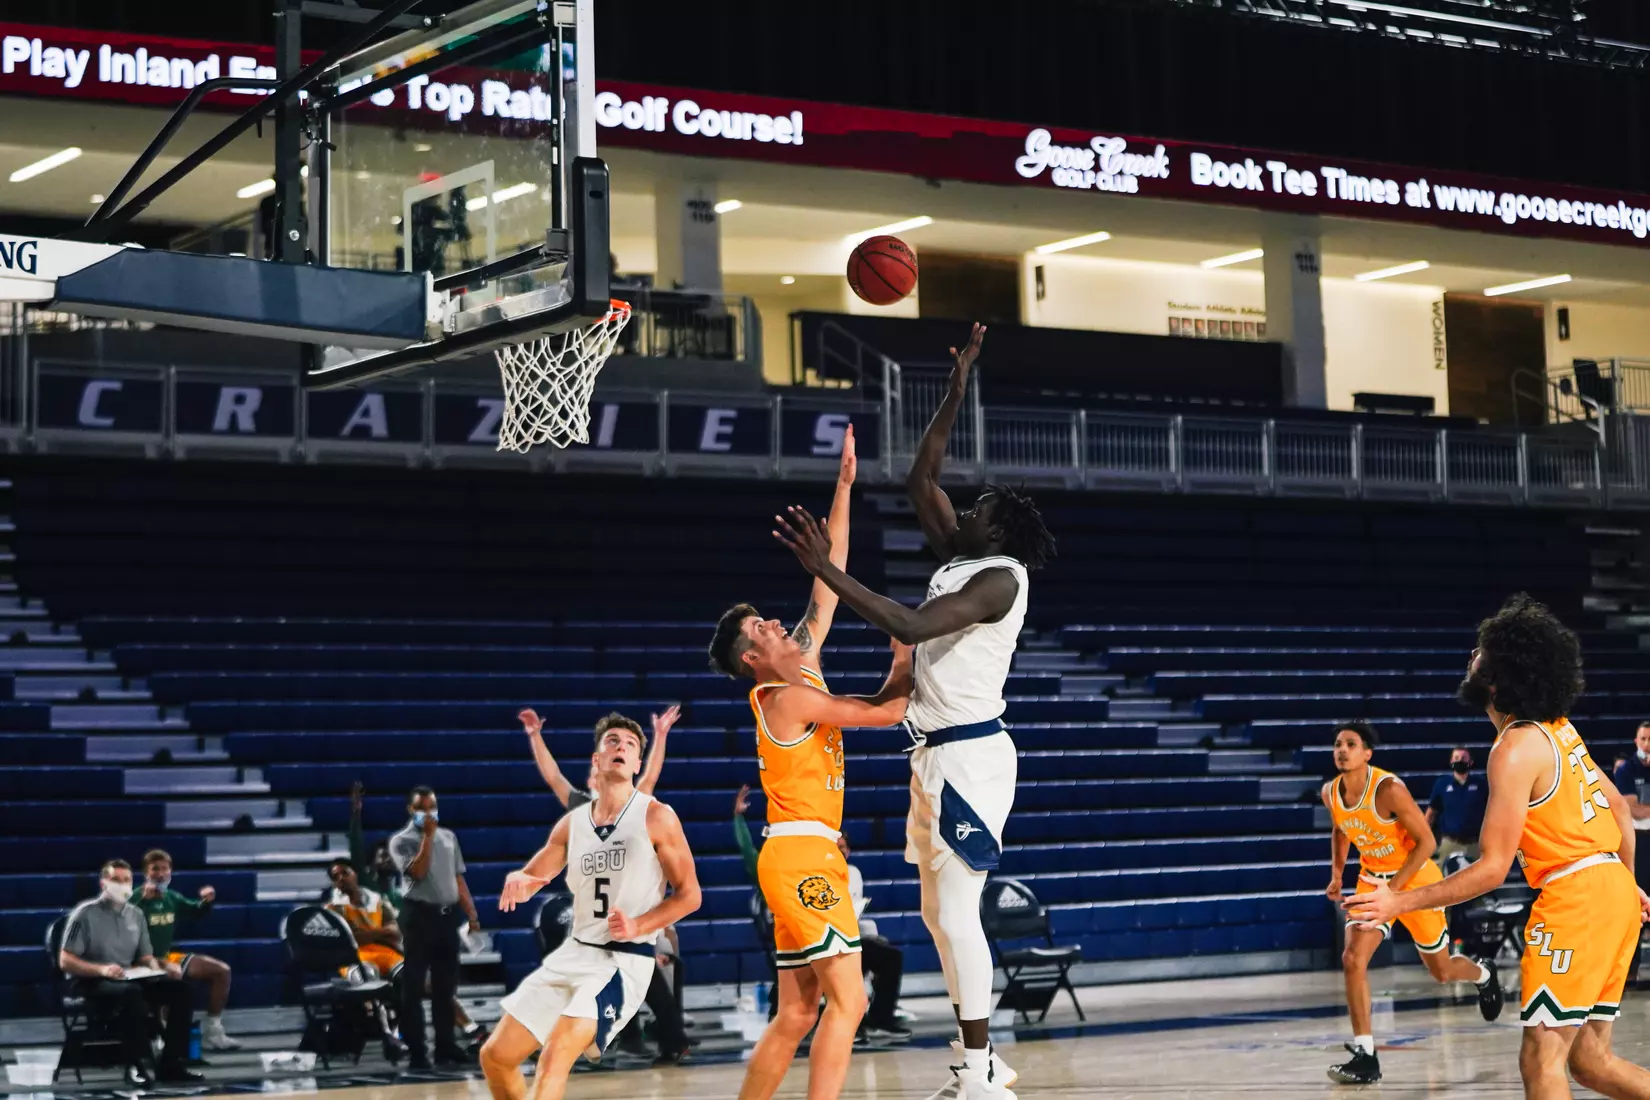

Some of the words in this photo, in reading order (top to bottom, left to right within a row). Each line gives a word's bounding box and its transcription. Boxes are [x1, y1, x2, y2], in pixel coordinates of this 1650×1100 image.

[3, 36, 90, 88] Play
[98, 44, 220, 89] Inland
[407, 74, 475, 121] Top
[594, 91, 669, 132] Golf
[672, 99, 804, 146] Course!
[1015, 128, 1095, 178] Goose
[1090, 136, 1170, 179] Creek
[1052, 167, 1096, 188] GOLF
[1096, 171, 1139, 193] CLUB
[1190, 152, 1265, 191] Book
[1266, 160, 1318, 196] Tee
[1320, 166, 1400, 205] Times
[1404, 178, 1431, 209] at
[1432, 300, 1446, 370] WOMEN
[1567, 742, 1611, 824] 25
[581, 849, 627, 876] CBU
[593, 877, 610, 919] 5
[1527, 922, 1574, 974] SLU
